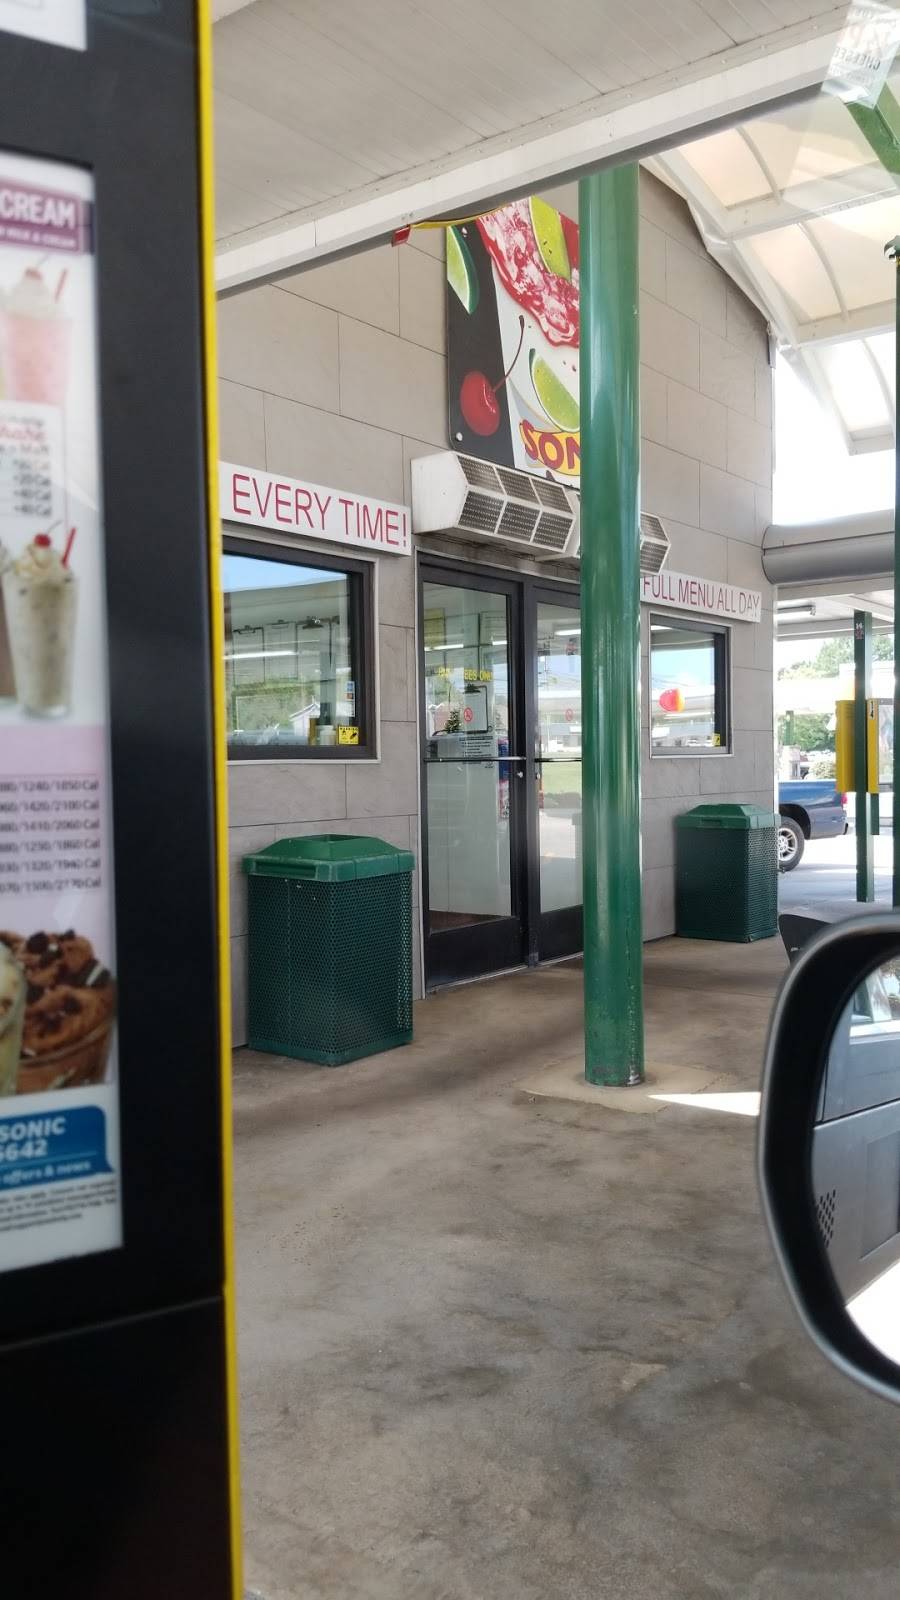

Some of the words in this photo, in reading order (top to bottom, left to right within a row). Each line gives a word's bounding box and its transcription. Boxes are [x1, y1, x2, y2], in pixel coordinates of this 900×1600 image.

[0, 189, 76, 230] CREAM
[232, 473, 331, 531] EVERY
[338, 498, 407, 548] TIME!
[643, 575, 675, 602] FULL
[678, 579, 715, 609] MENU
[717, 588, 736, 613] ALL
[739, 592, 760, 618] DAY
[0, 1116, 66, 1144] SONIC
